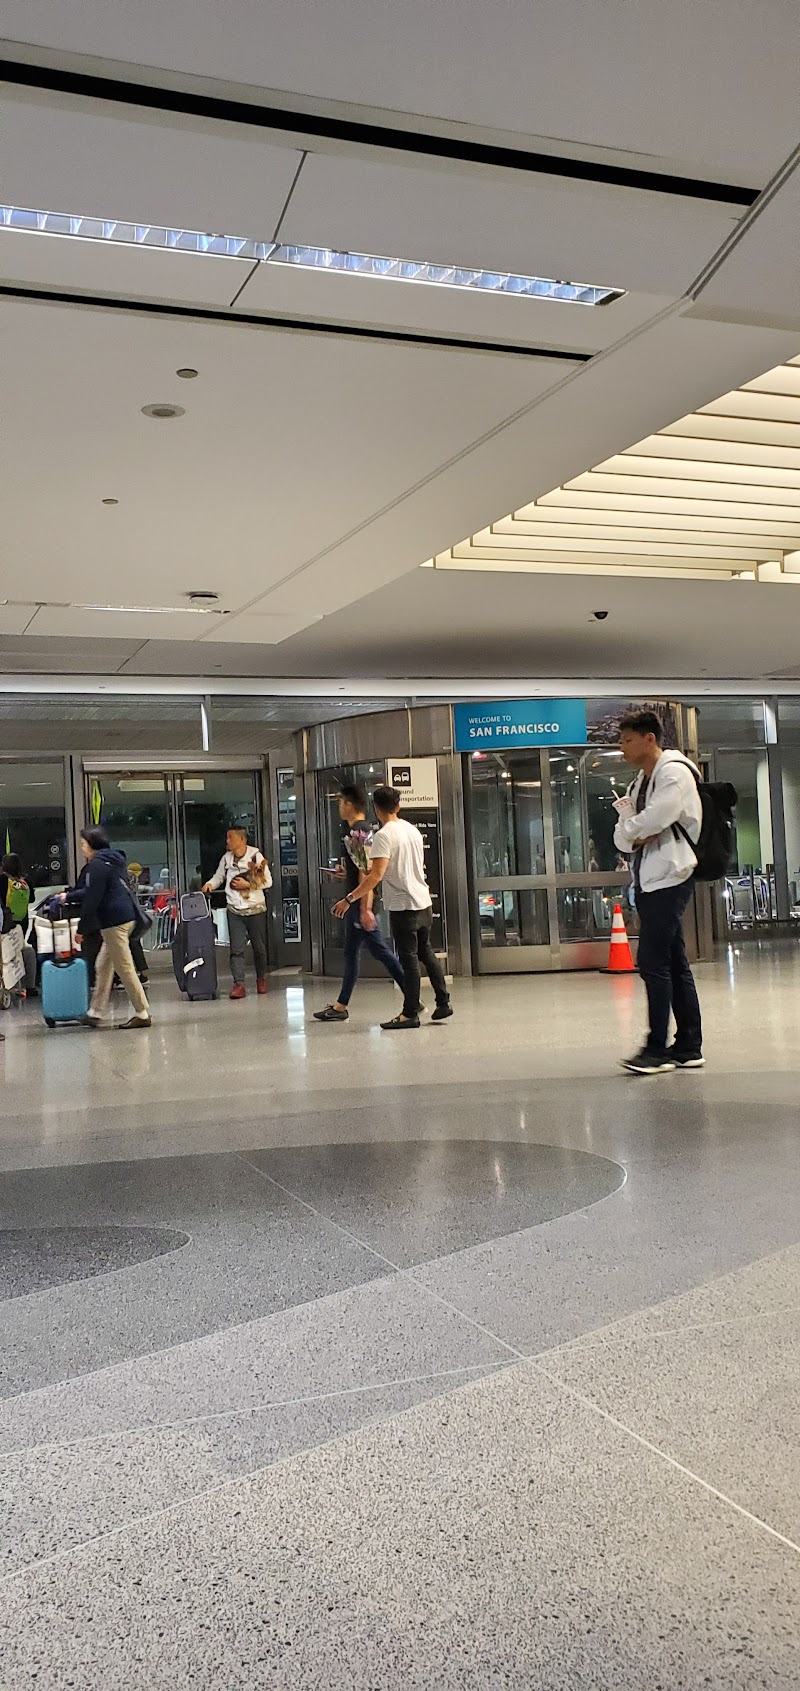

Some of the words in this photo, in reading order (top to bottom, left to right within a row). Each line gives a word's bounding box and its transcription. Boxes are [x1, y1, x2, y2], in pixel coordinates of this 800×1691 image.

[468, 715, 501, 724] WELCOME
[469, 726, 492, 737] SAN
[496, 723, 560, 735] FRANCISCO
[400, 795, 434, 803] nsportation
[283, 866, 298, 875] Doo
